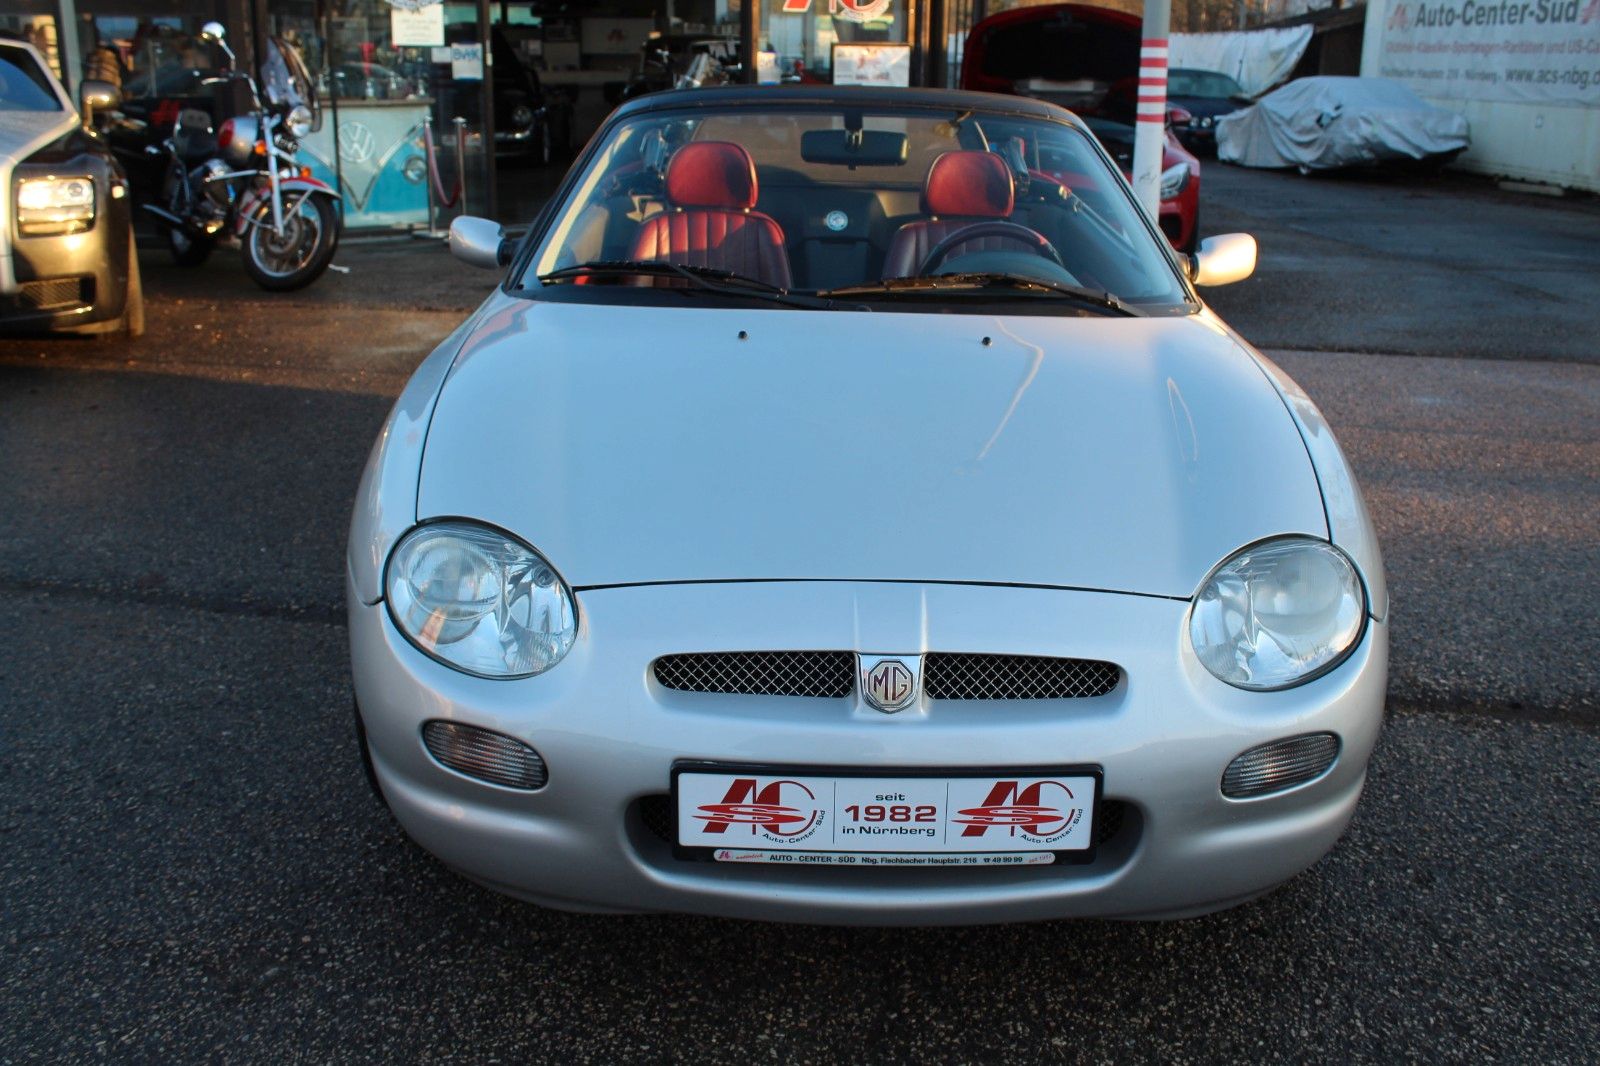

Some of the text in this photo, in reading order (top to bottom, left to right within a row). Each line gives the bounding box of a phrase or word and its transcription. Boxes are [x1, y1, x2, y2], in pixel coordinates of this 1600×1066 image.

[873, 666, 908, 701] MG
[875, 792, 906, 801] seit
[844, 805, 937, 822] 1982
[842, 825, 936, 837] in Nürnberg
[769, 854, 793, 862] AUTO
[798, 855, 833, 863] CENTER
[838, 855, 856, 863] SÜD
